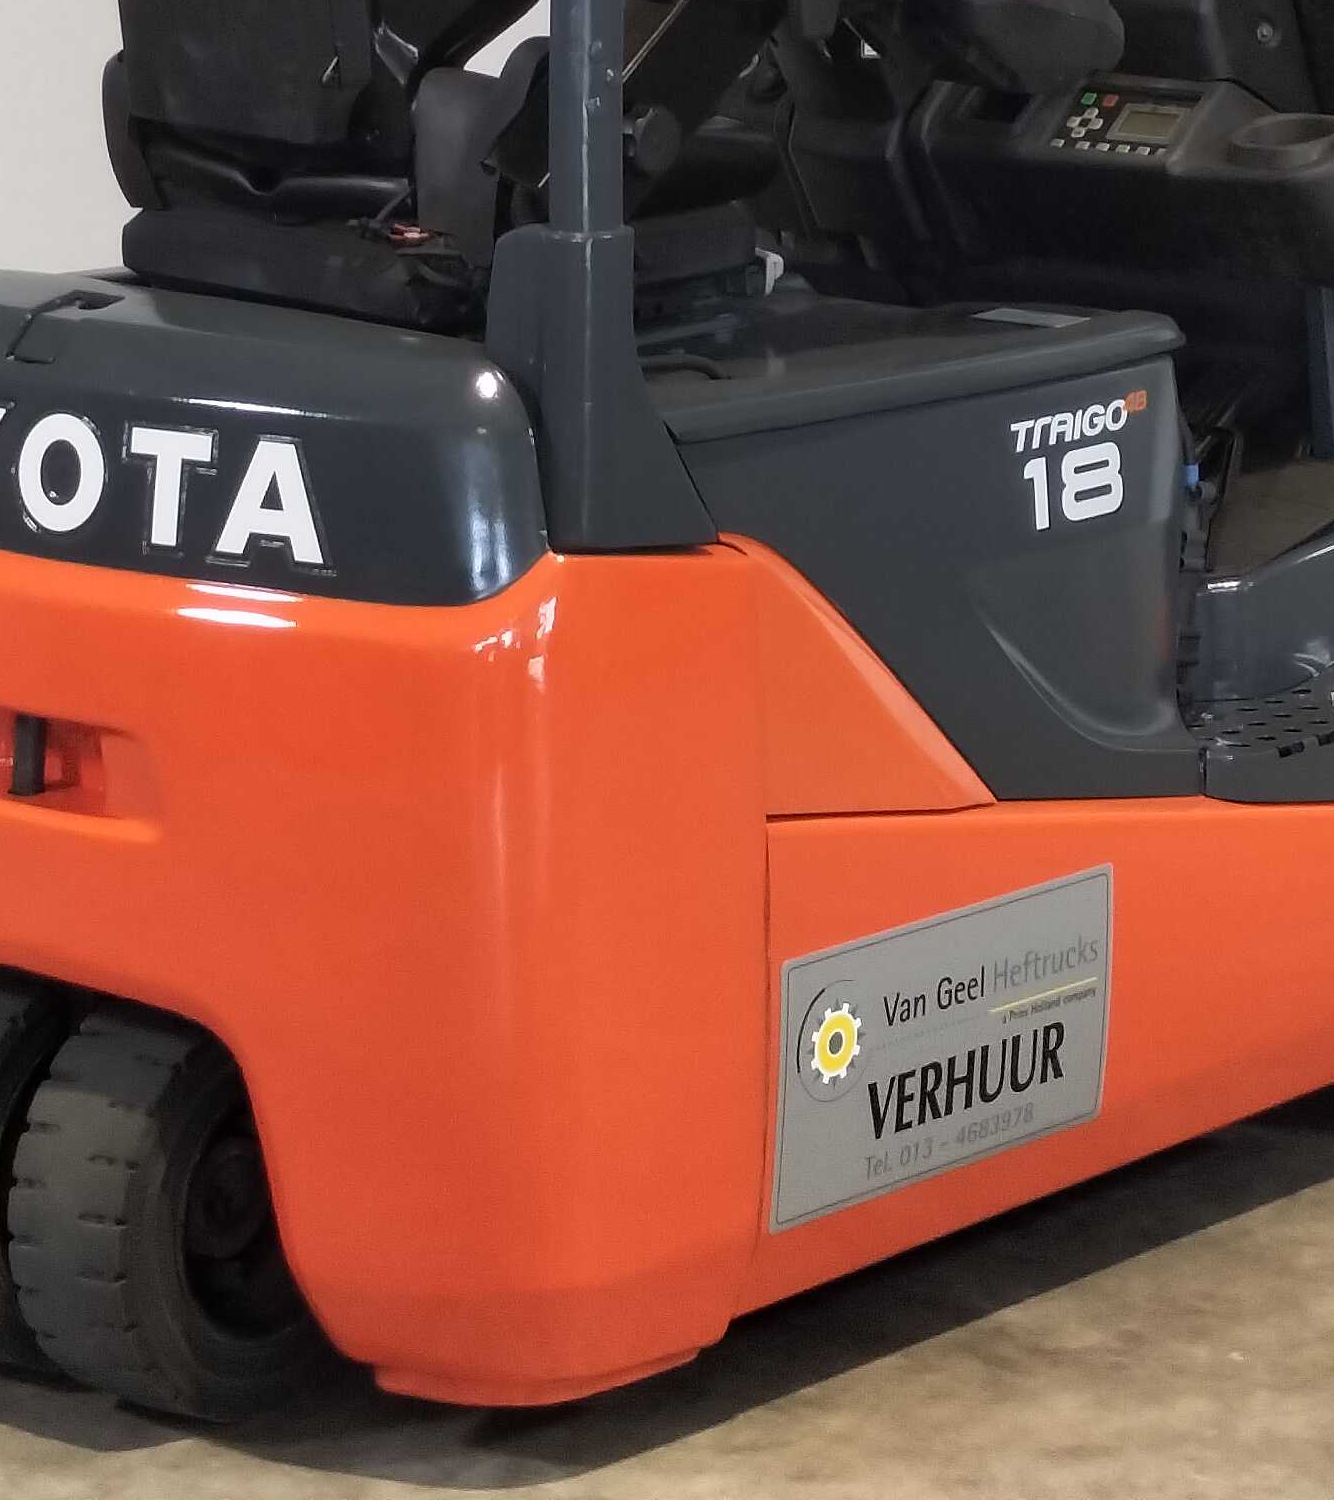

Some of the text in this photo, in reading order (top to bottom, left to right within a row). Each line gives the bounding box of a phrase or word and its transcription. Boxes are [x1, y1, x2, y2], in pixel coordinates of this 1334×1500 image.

[1023, 442, 1124, 531] 18
[883, 934, 1099, 1027] Van Geel Heftrucks
[868, 1021, 1065, 1140] VERHUUR
[900, 1137, 934, 1166] 013
